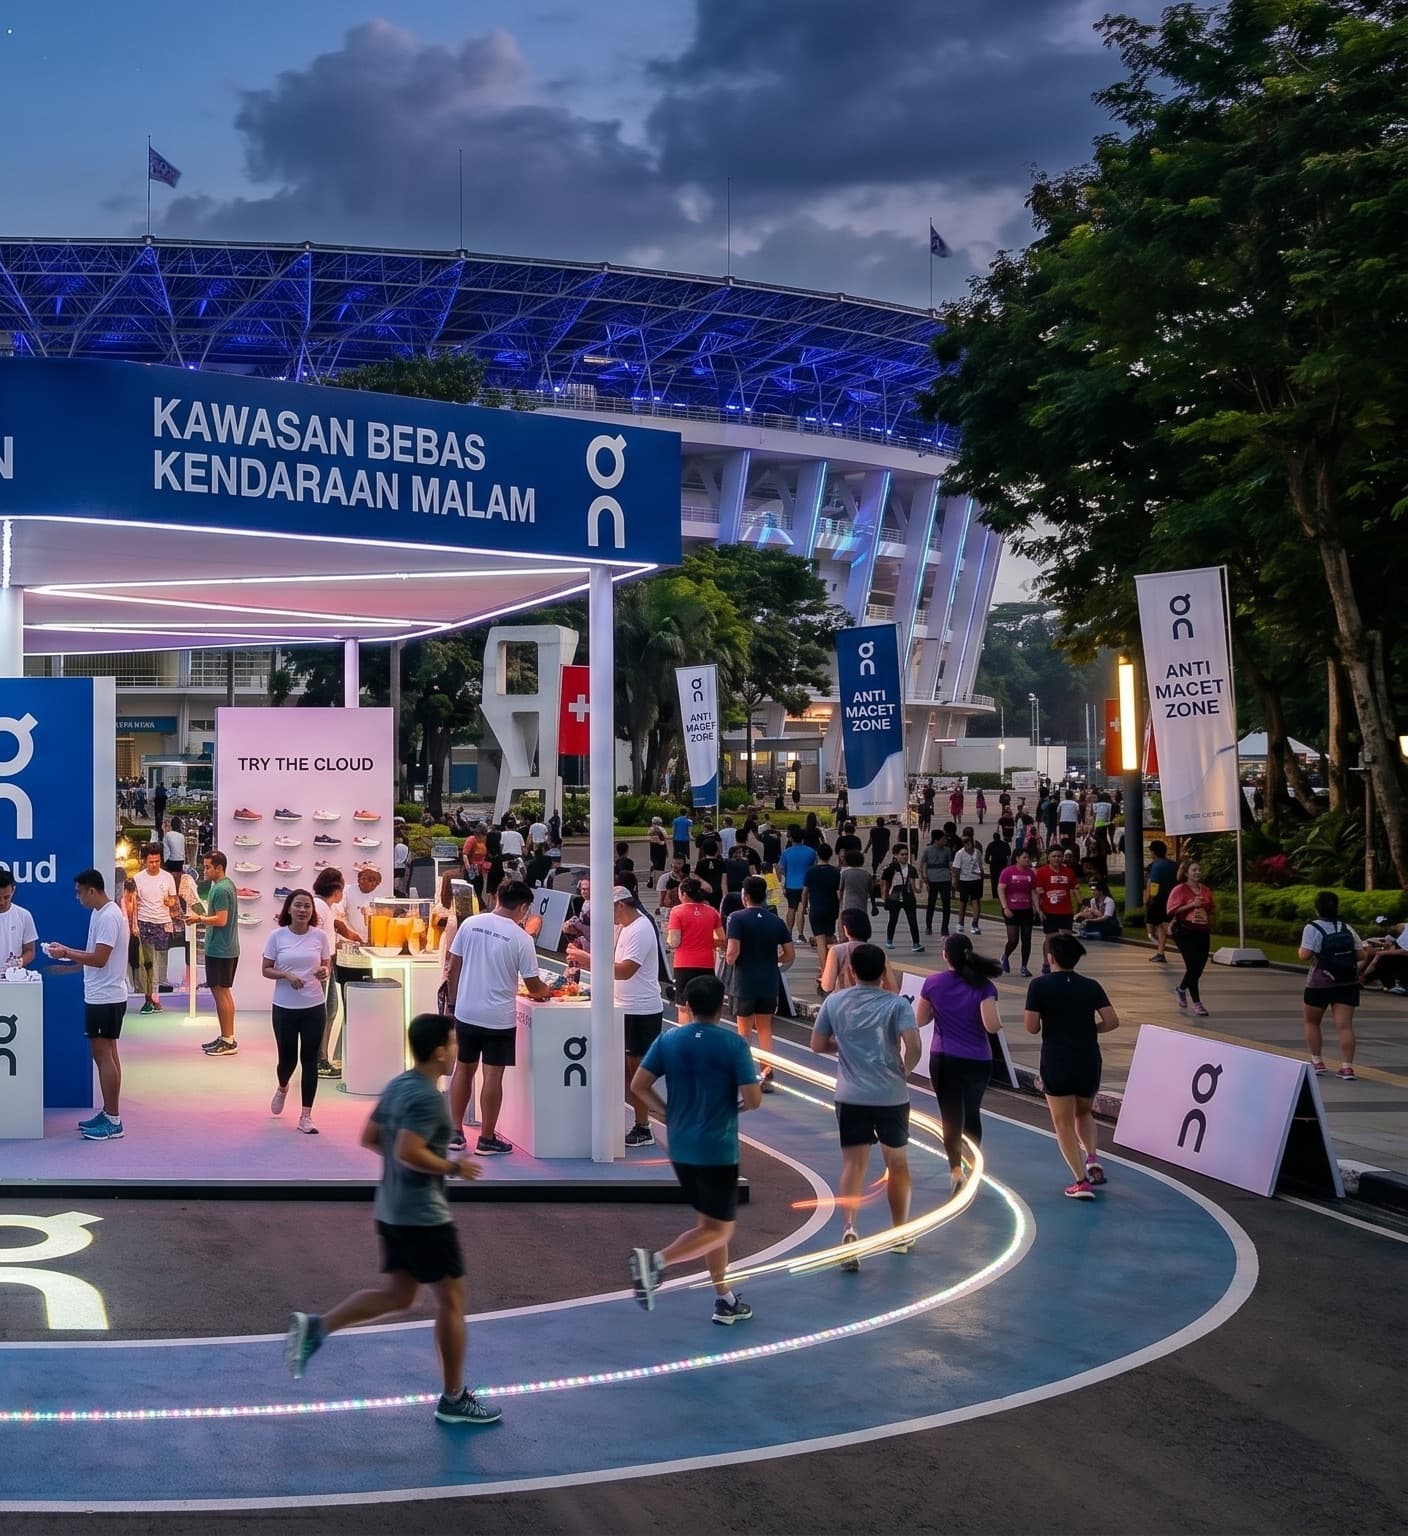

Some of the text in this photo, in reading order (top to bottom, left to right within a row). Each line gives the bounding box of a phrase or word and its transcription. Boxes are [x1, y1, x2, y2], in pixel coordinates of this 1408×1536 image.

[153, 396, 486, 471] KAWASAN BEBAS
[154, 449, 536, 524] KENDARAAN MALAM
[1166, 660, 1211, 680] ANTI
[852, 689, 886, 704] ANTI
[1155, 678, 1224, 700] MACET
[690, 711, 712, 723] ANTI
[845, 703, 896, 718] MACET
[1165, 699, 1220, 719] ZONE
[852, 718, 891, 732] ZONE
[237, 756, 374, 771] TRY THE CLOUD
